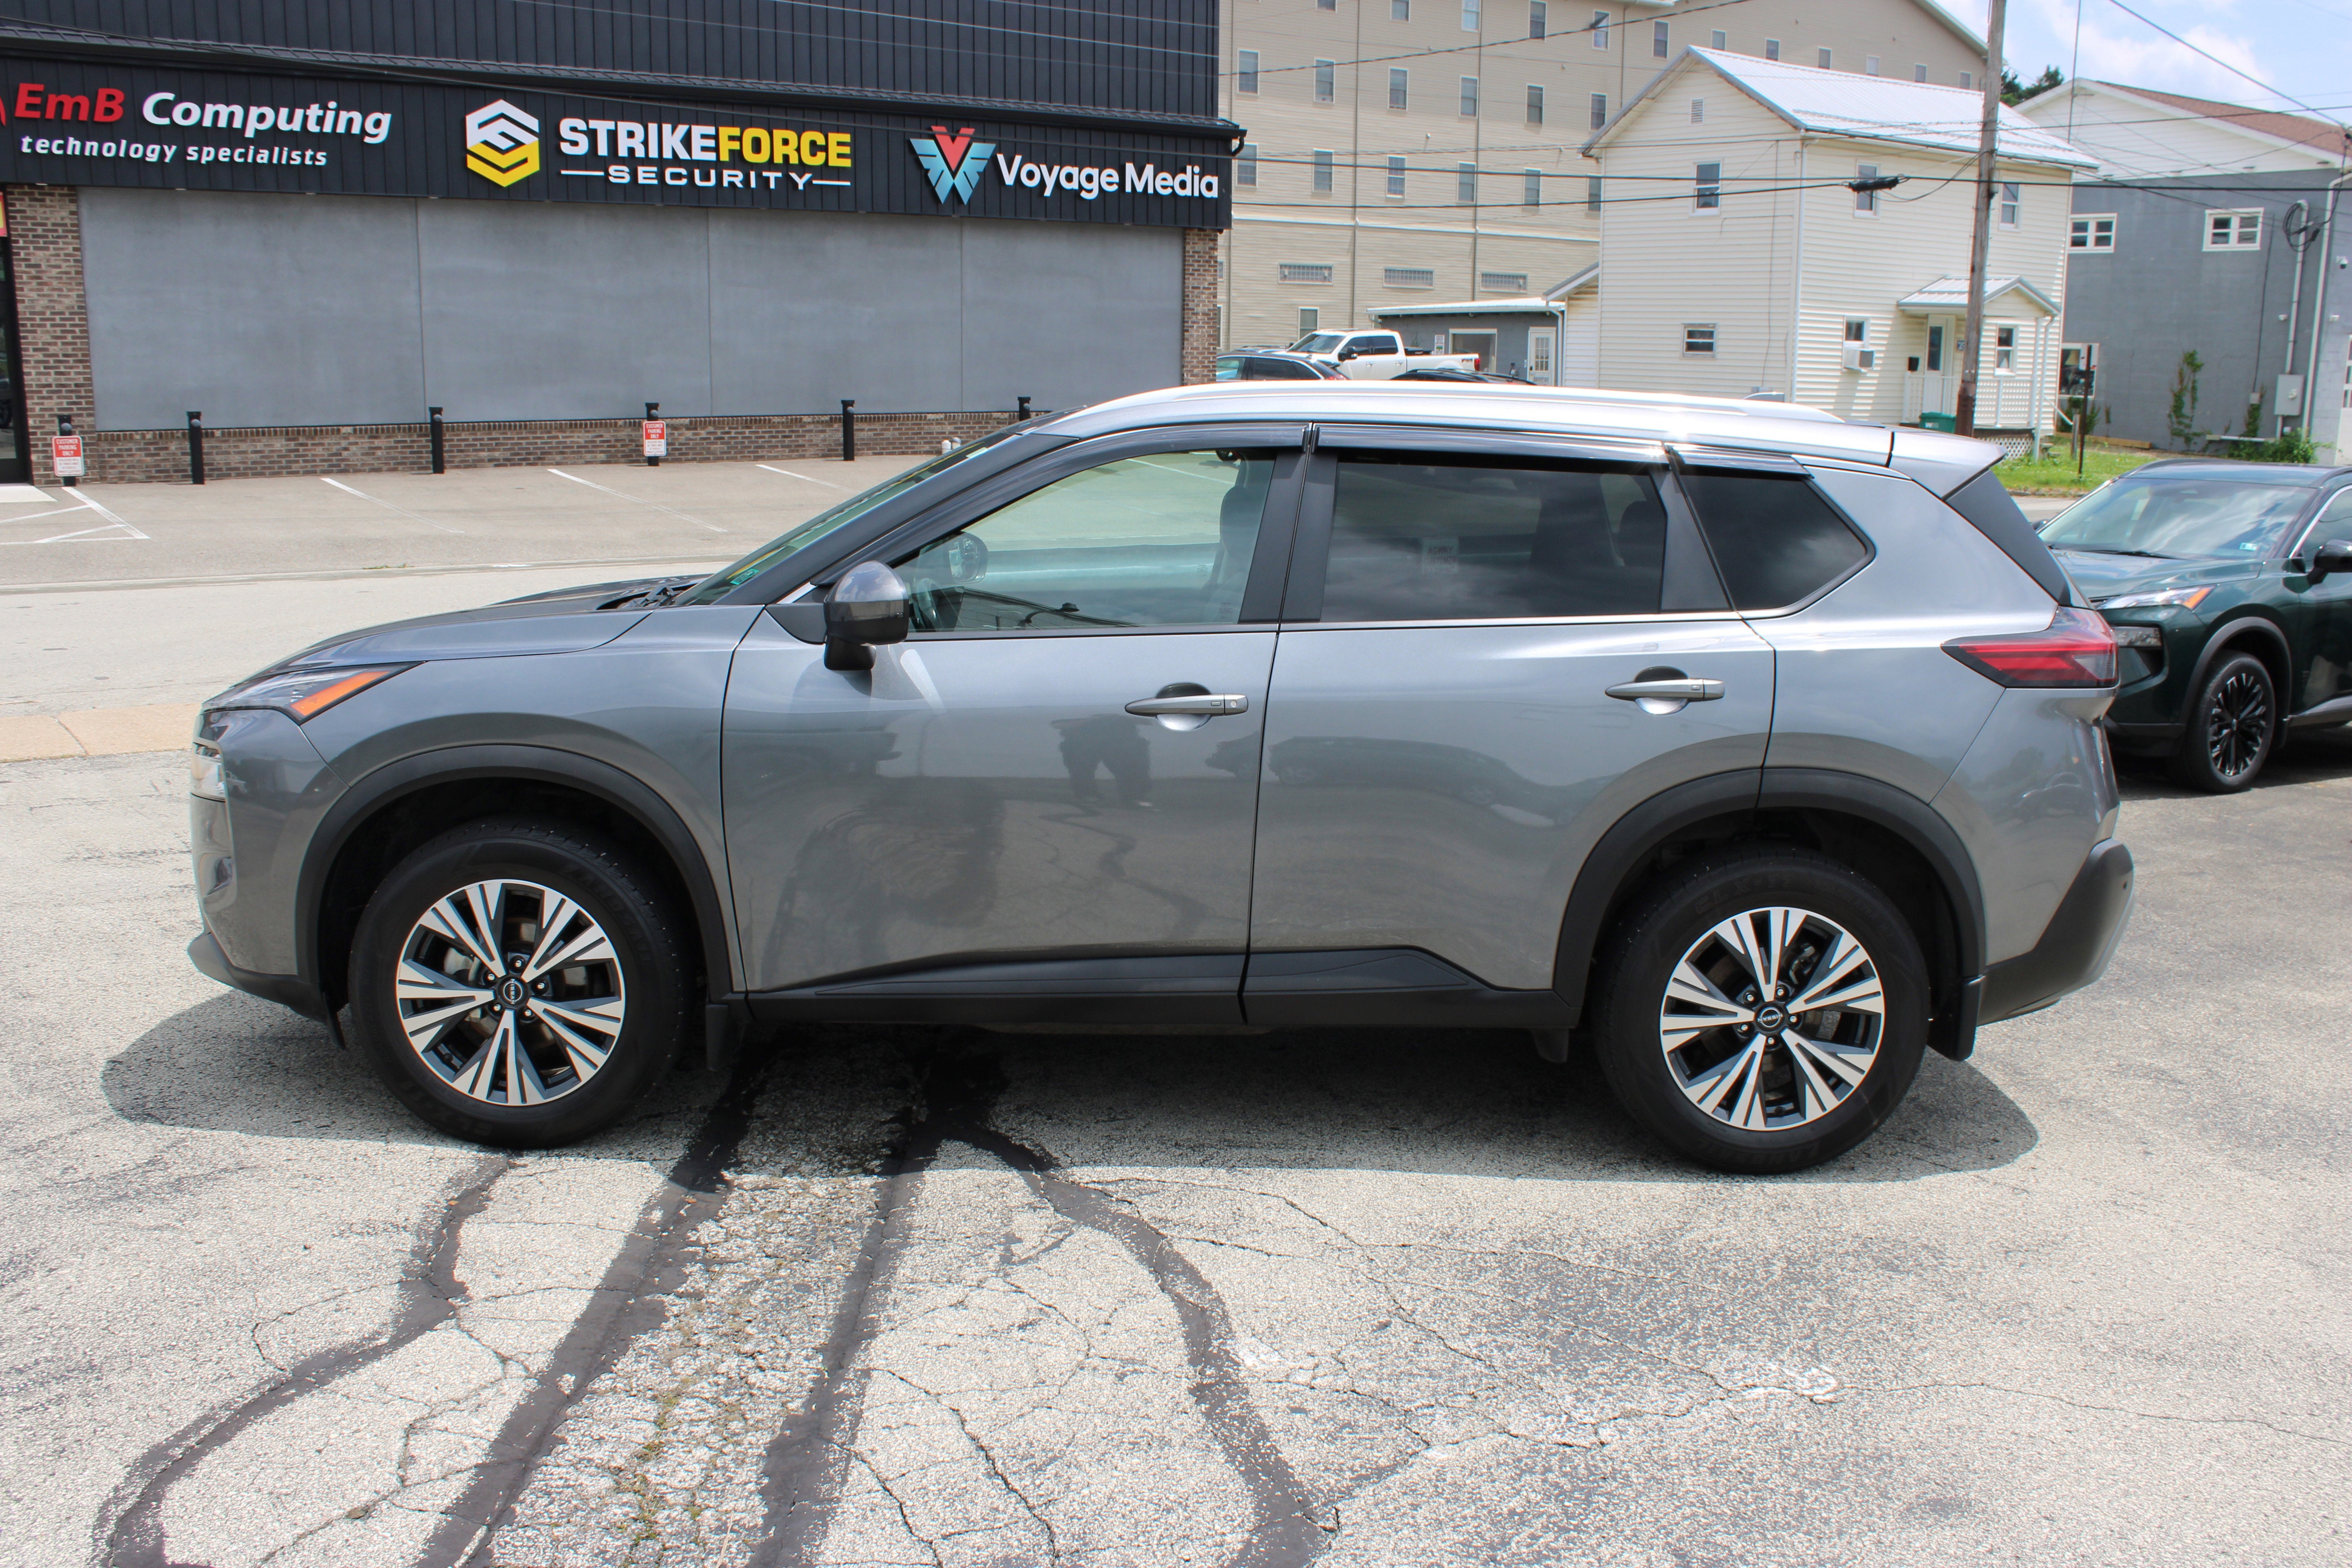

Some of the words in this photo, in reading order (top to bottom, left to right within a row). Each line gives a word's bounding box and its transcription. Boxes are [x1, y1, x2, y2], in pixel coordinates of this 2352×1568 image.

[14, 82, 125, 122] EmB
[142, 92, 392, 144] Computing
[21, 135, 177, 163] technology
[186, 145, 327, 165] specialists
[559, 118, 852, 167] STRIKEFORCE
[608, 165, 812, 190] SECURITY
[996, 153, 1120, 199] Voyage
[1125, 162, 1219, 198] Media
[1757, 1013, 1783, 1022] NISSAN
